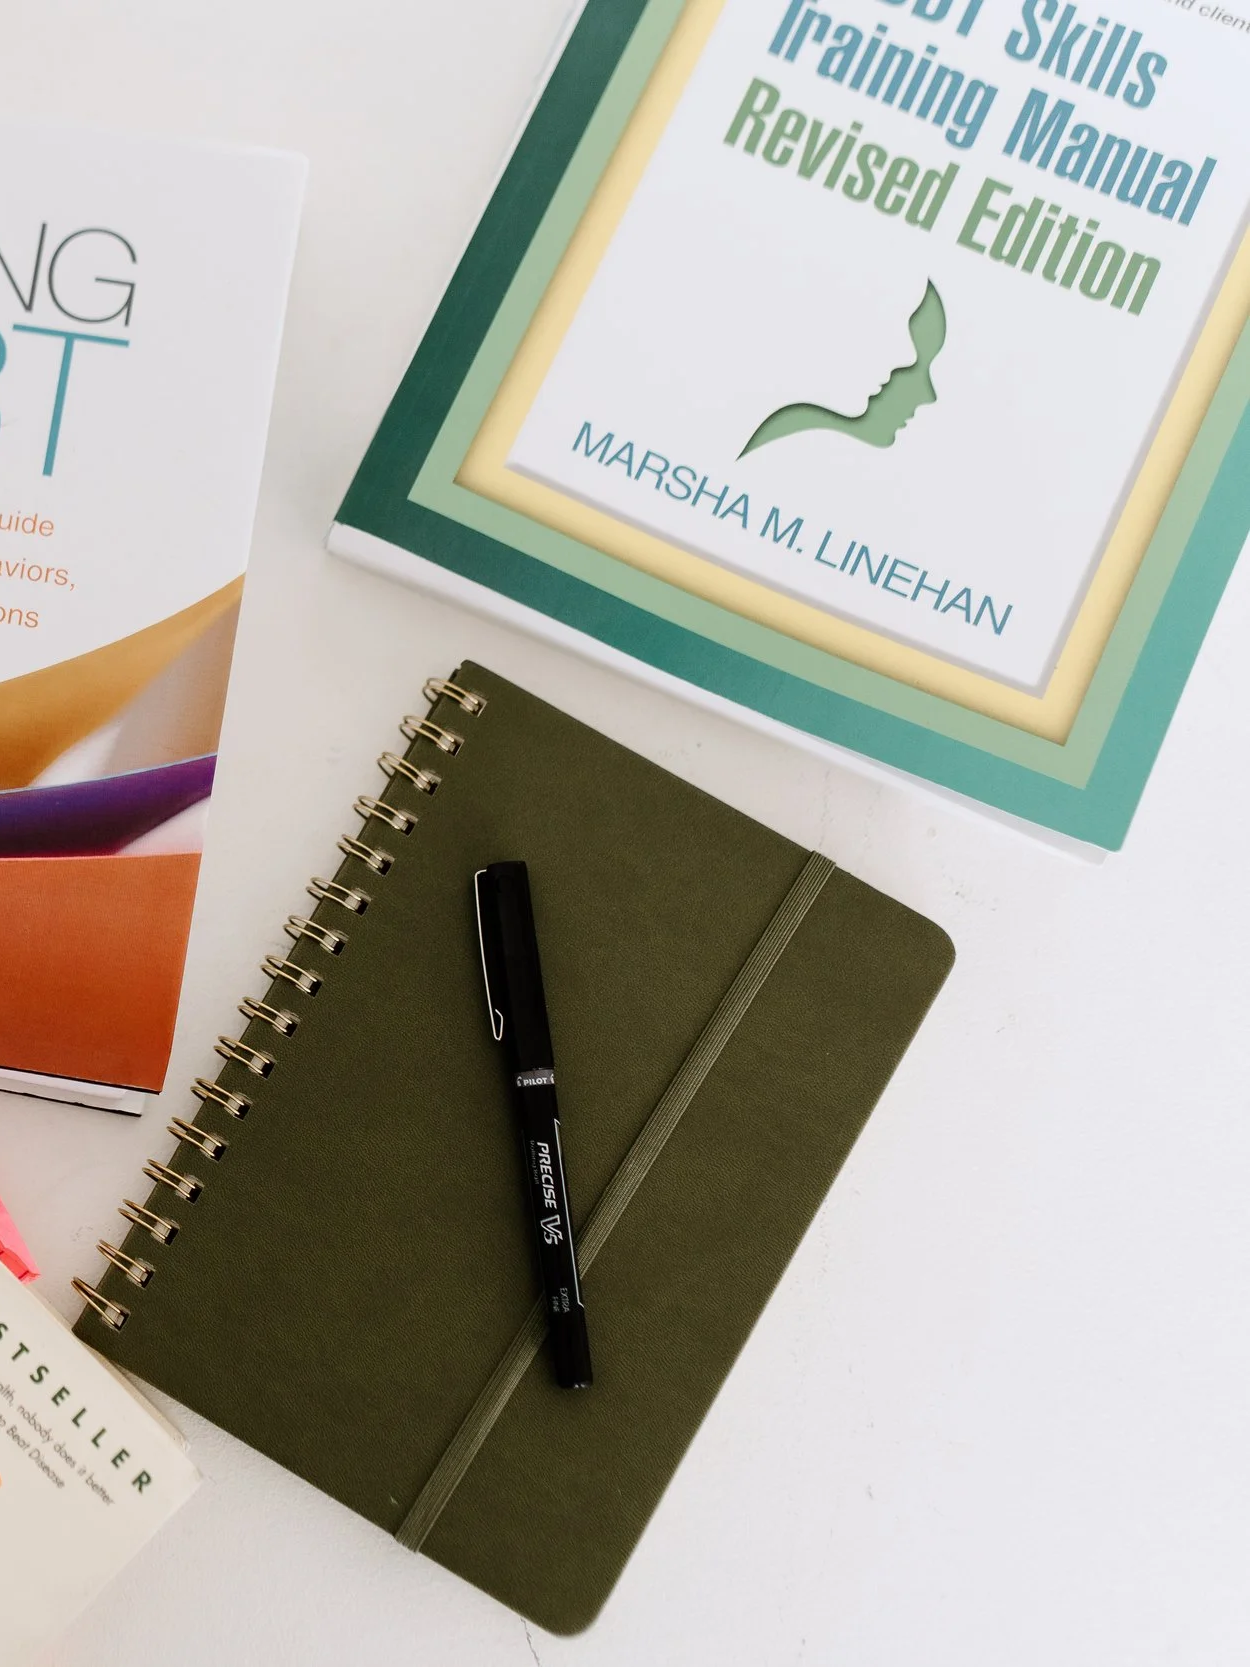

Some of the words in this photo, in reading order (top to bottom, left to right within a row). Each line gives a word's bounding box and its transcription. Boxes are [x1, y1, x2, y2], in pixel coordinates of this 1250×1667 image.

[1004, 0, 1168, 109] Skills
[768, 0, 998, 150] Training
[1002, 86, 1218, 228] Manual
[723, 78, 960, 232] Revised
[956, 177, 1162, 317] Edition
[571, 421, 750, 530] MARSHA
[759, 505, 804, 554] M.
[814, 529, 1013, 636] LINEHAN
[523, 1077, 548, 1086] PILOT
[536, 1141, 558, 1210] PRECISE
[540, 1213, 564, 1246] V5
[559, 1286, 570, 1313] EXTRA
[5, 1425, 30, 1453] Beat
[28, 1447, 66, 1489] Disease
[16, 1401, 53, 1443] nobody
[53, 1440, 77, 1468] does
